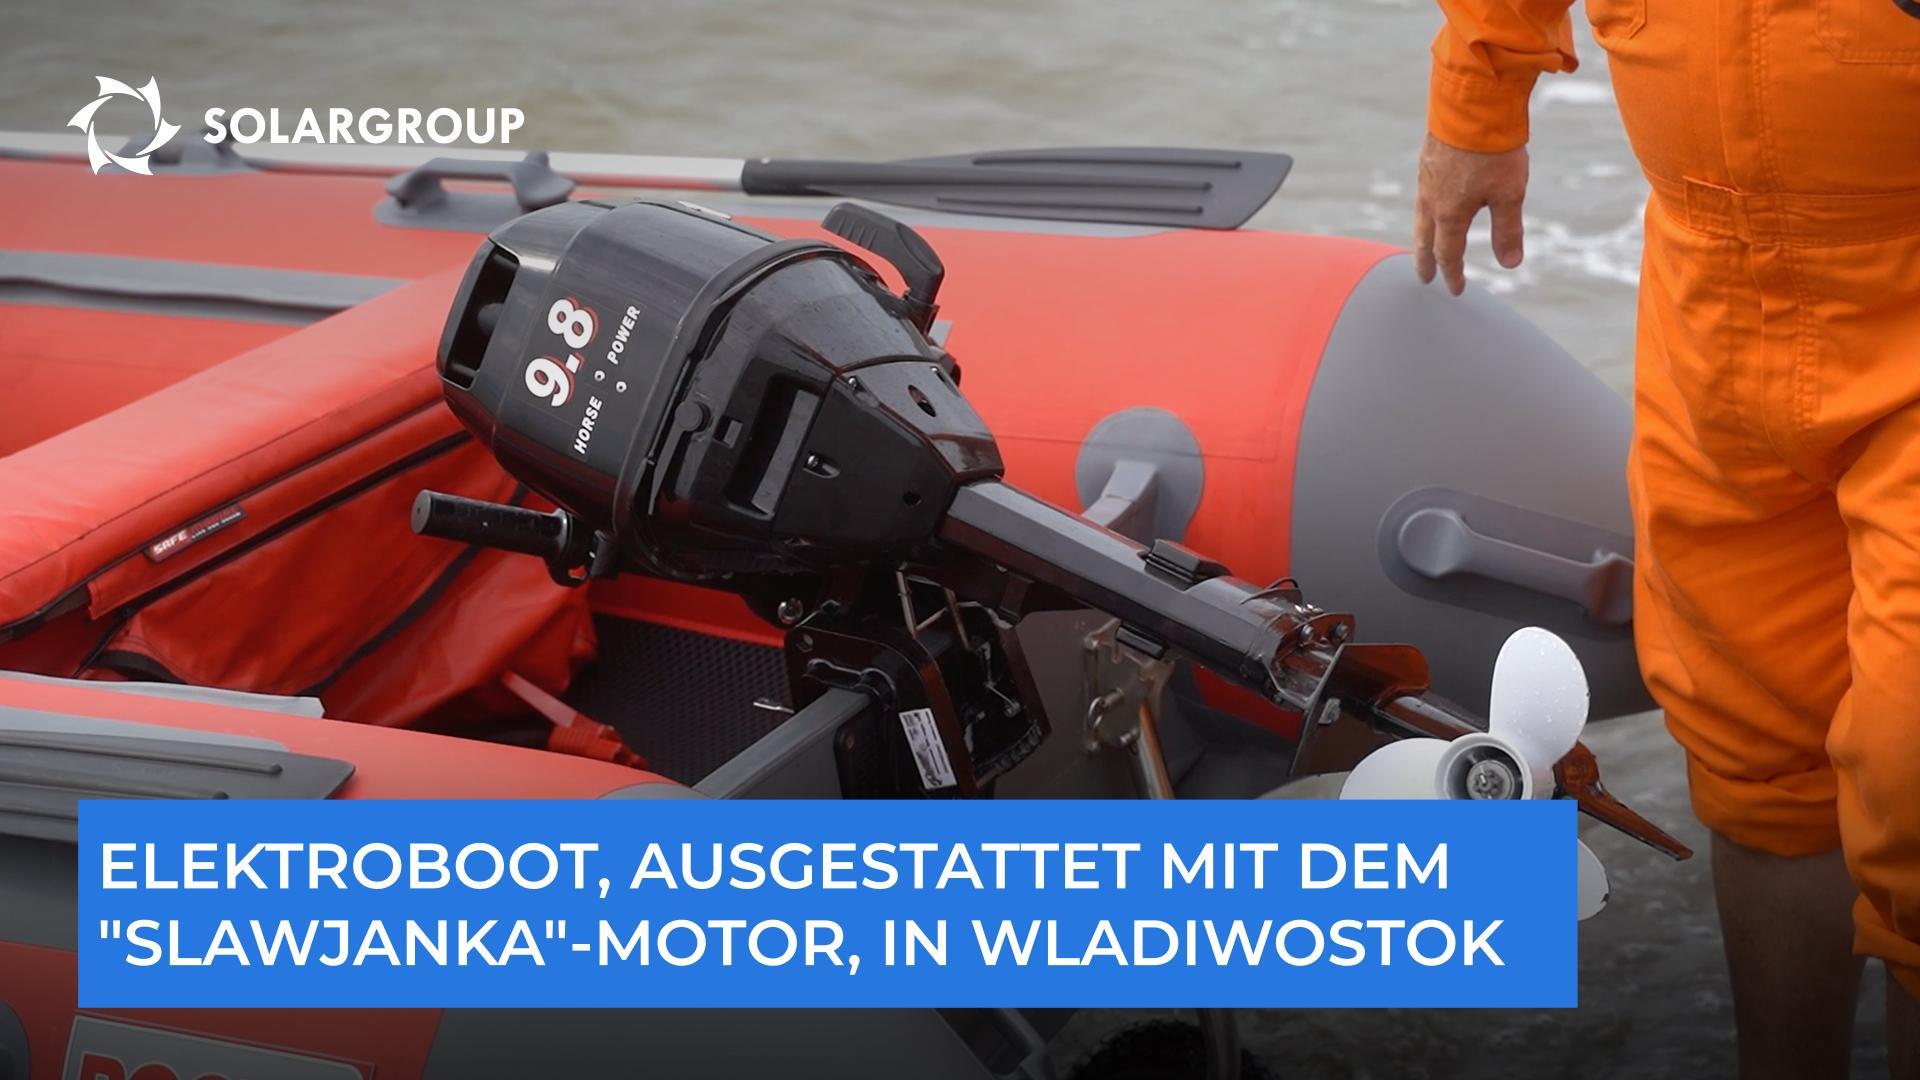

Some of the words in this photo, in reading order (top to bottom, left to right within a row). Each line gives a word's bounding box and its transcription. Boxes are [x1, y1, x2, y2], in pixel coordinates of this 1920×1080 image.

[525, 298, 599, 407] 9.8
[574, 396, 603, 455] HORSE
[607, 305, 641, 365] POWER
